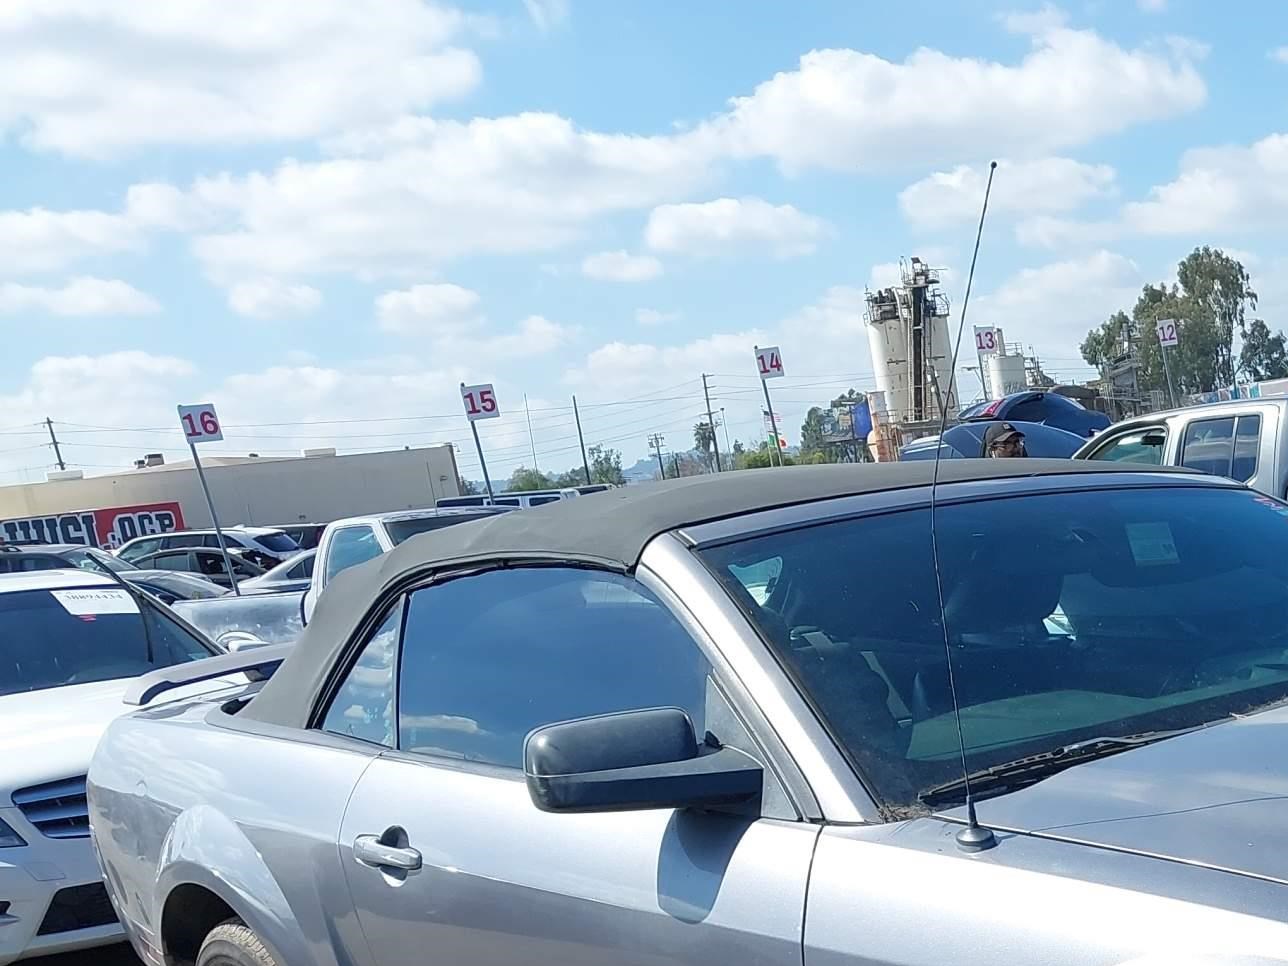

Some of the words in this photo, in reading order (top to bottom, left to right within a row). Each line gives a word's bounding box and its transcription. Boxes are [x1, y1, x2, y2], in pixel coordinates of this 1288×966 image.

[976, 331, 994, 350] 13
[1159, 324, 1176, 341] 12
[757, 352, 782, 374] 14
[463, 390, 496, 414] 15
[182, 411, 219, 437] 16
